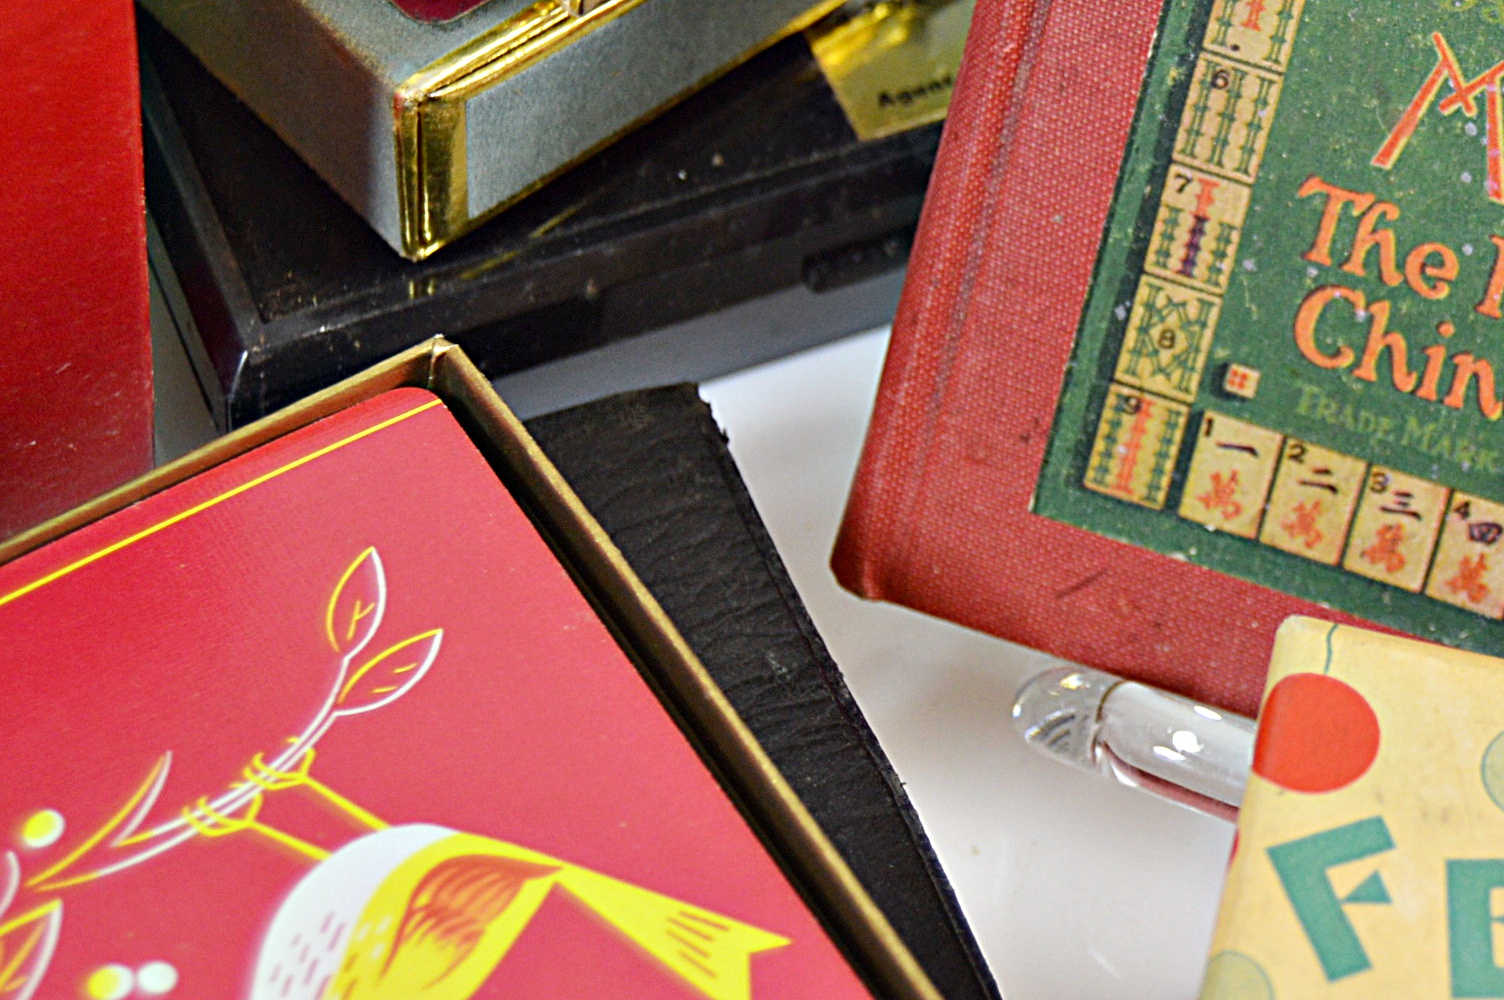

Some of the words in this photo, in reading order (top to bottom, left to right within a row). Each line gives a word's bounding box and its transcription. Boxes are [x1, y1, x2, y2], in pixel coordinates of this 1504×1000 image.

[1210, 69, 1229, 90] 6
[1174, 173, 1193, 194] 7
[1299, 175, 1459, 300] The
[1158, 329, 1176, 350] 8
[1204, 418, 1214, 437] 1
[1287, 443, 1307, 463] 2
[1369, 471, 1389, 492] 3
[1452, 501, 1470, 519] 4
